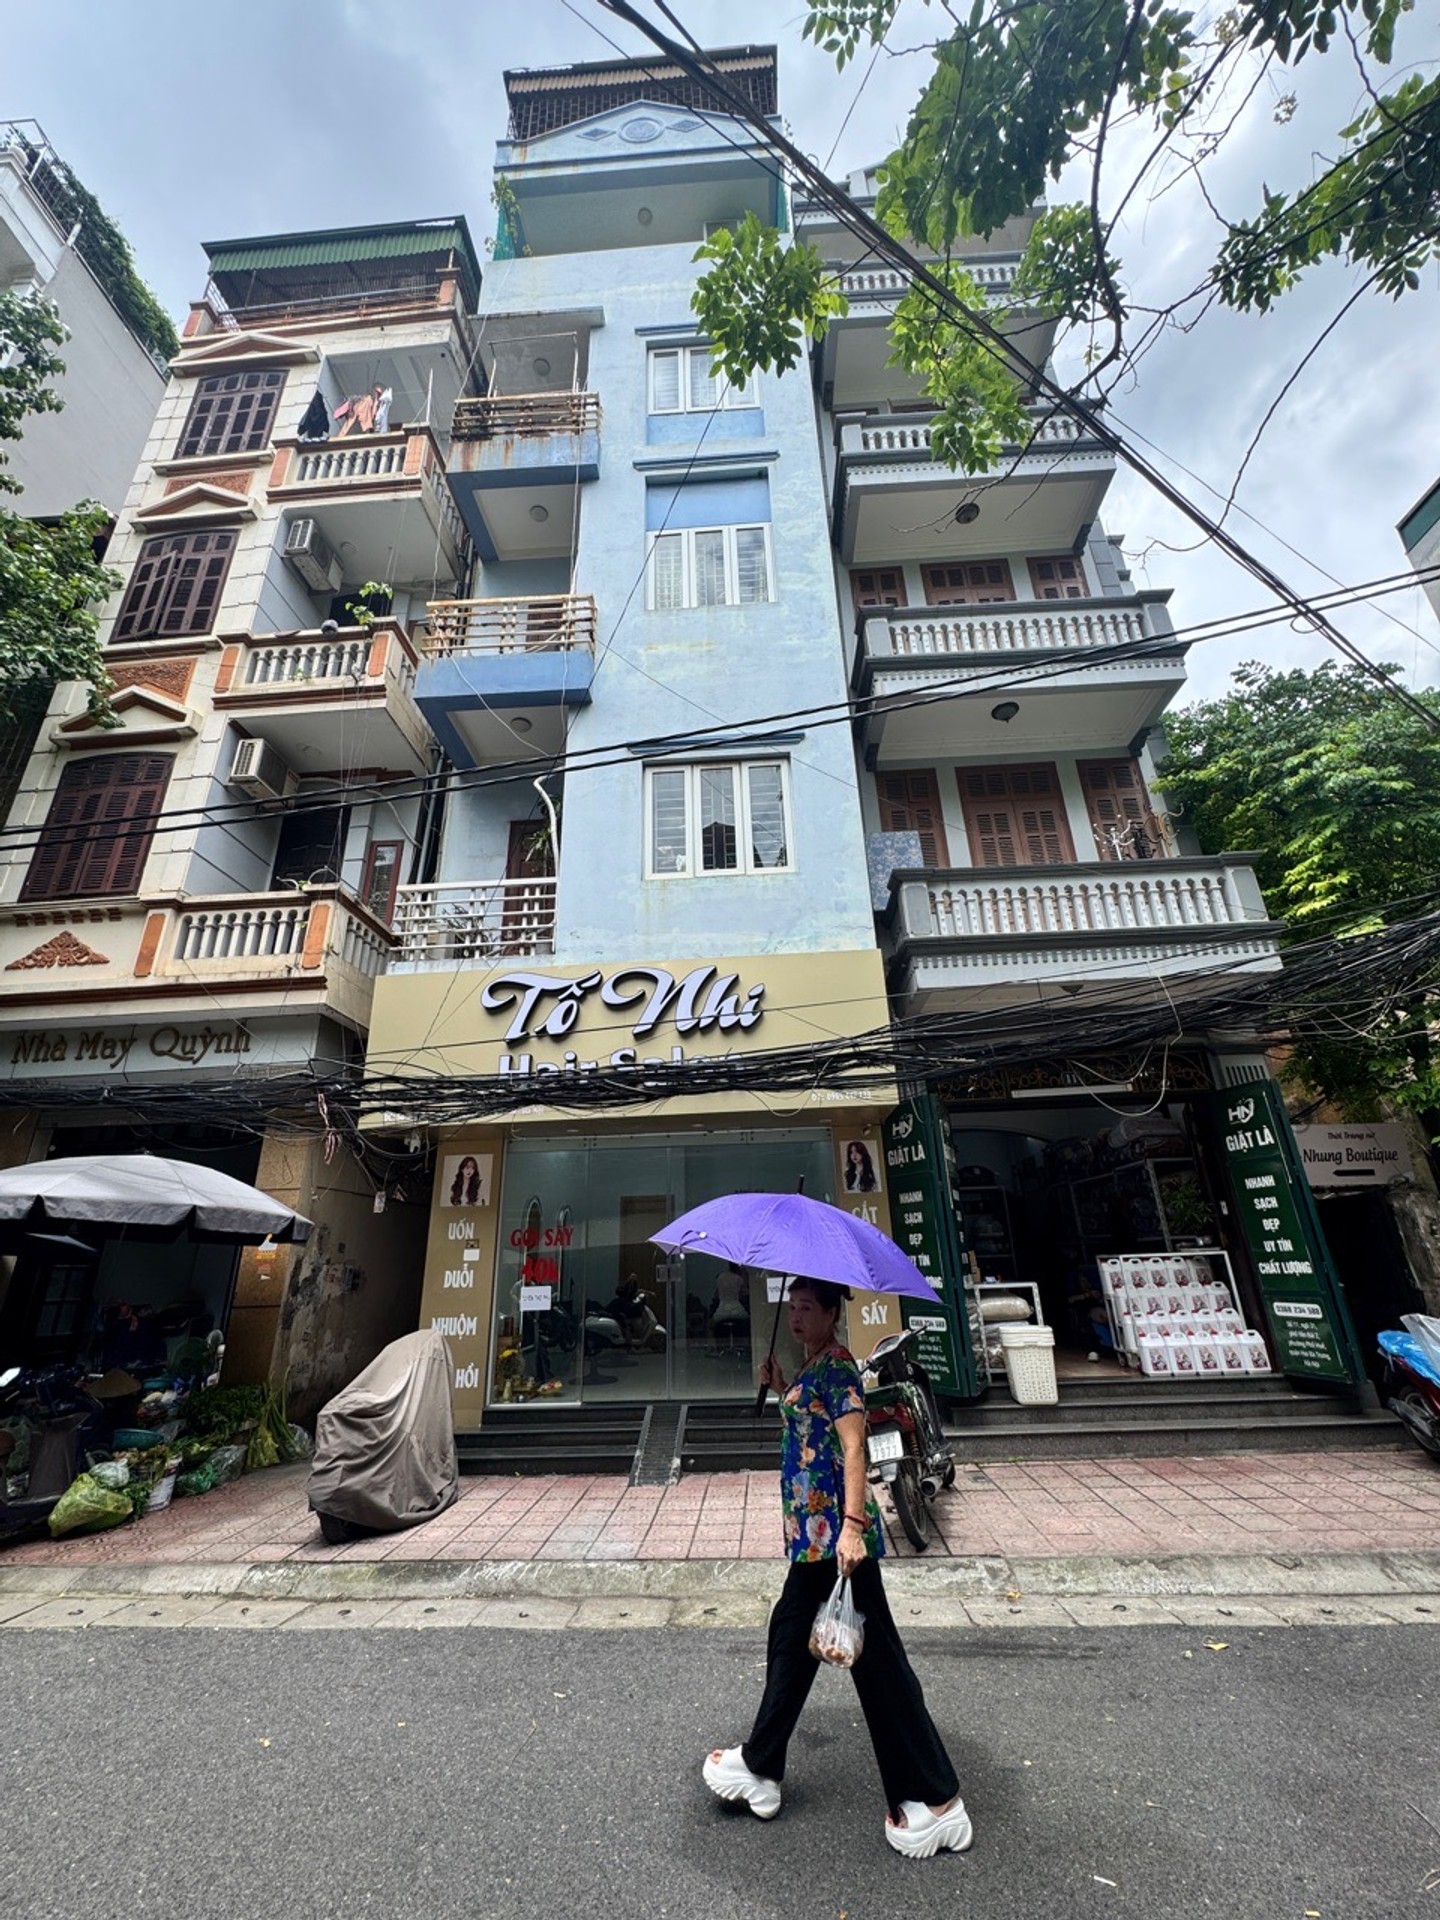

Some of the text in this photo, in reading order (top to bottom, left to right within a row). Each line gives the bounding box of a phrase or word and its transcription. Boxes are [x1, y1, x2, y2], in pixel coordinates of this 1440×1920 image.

[480, 965, 767, 1043] Tố Nhi
[10, 1031, 68, 1065] Nhà
[1225, 1124, 1275, 1153] GIẶT LÀ
[888, 1146, 909, 1167] GIẶT
[911, 1140, 926, 1161] LÀ
[1303, 1147, 1399, 1165] Nhung Boutique
[1244, 1175, 1276, 1190] NHANH
[899, 1190, 924, 1204] NHANH
[1253, 1196, 1279, 1212] SẠCH
[904, 1211, 924, 1227] SẠCH
[1262, 1218, 1280, 1232] ĐẸP
[448, 1218, 475, 1240] UỐN
[909, 1233, 924, 1248] ĐẸP
[1263, 1236, 1294, 1252] UY TÍN
[918, 1252, 931, 1267] TÍN
[1258, 1258, 1313, 1277] CHẤT LƯỢNG
[443, 1263, 474, 1289] DUỖI
[861, 1300, 888, 1326] SẤY
[431, 1313, 478, 1340] NHUỘM
